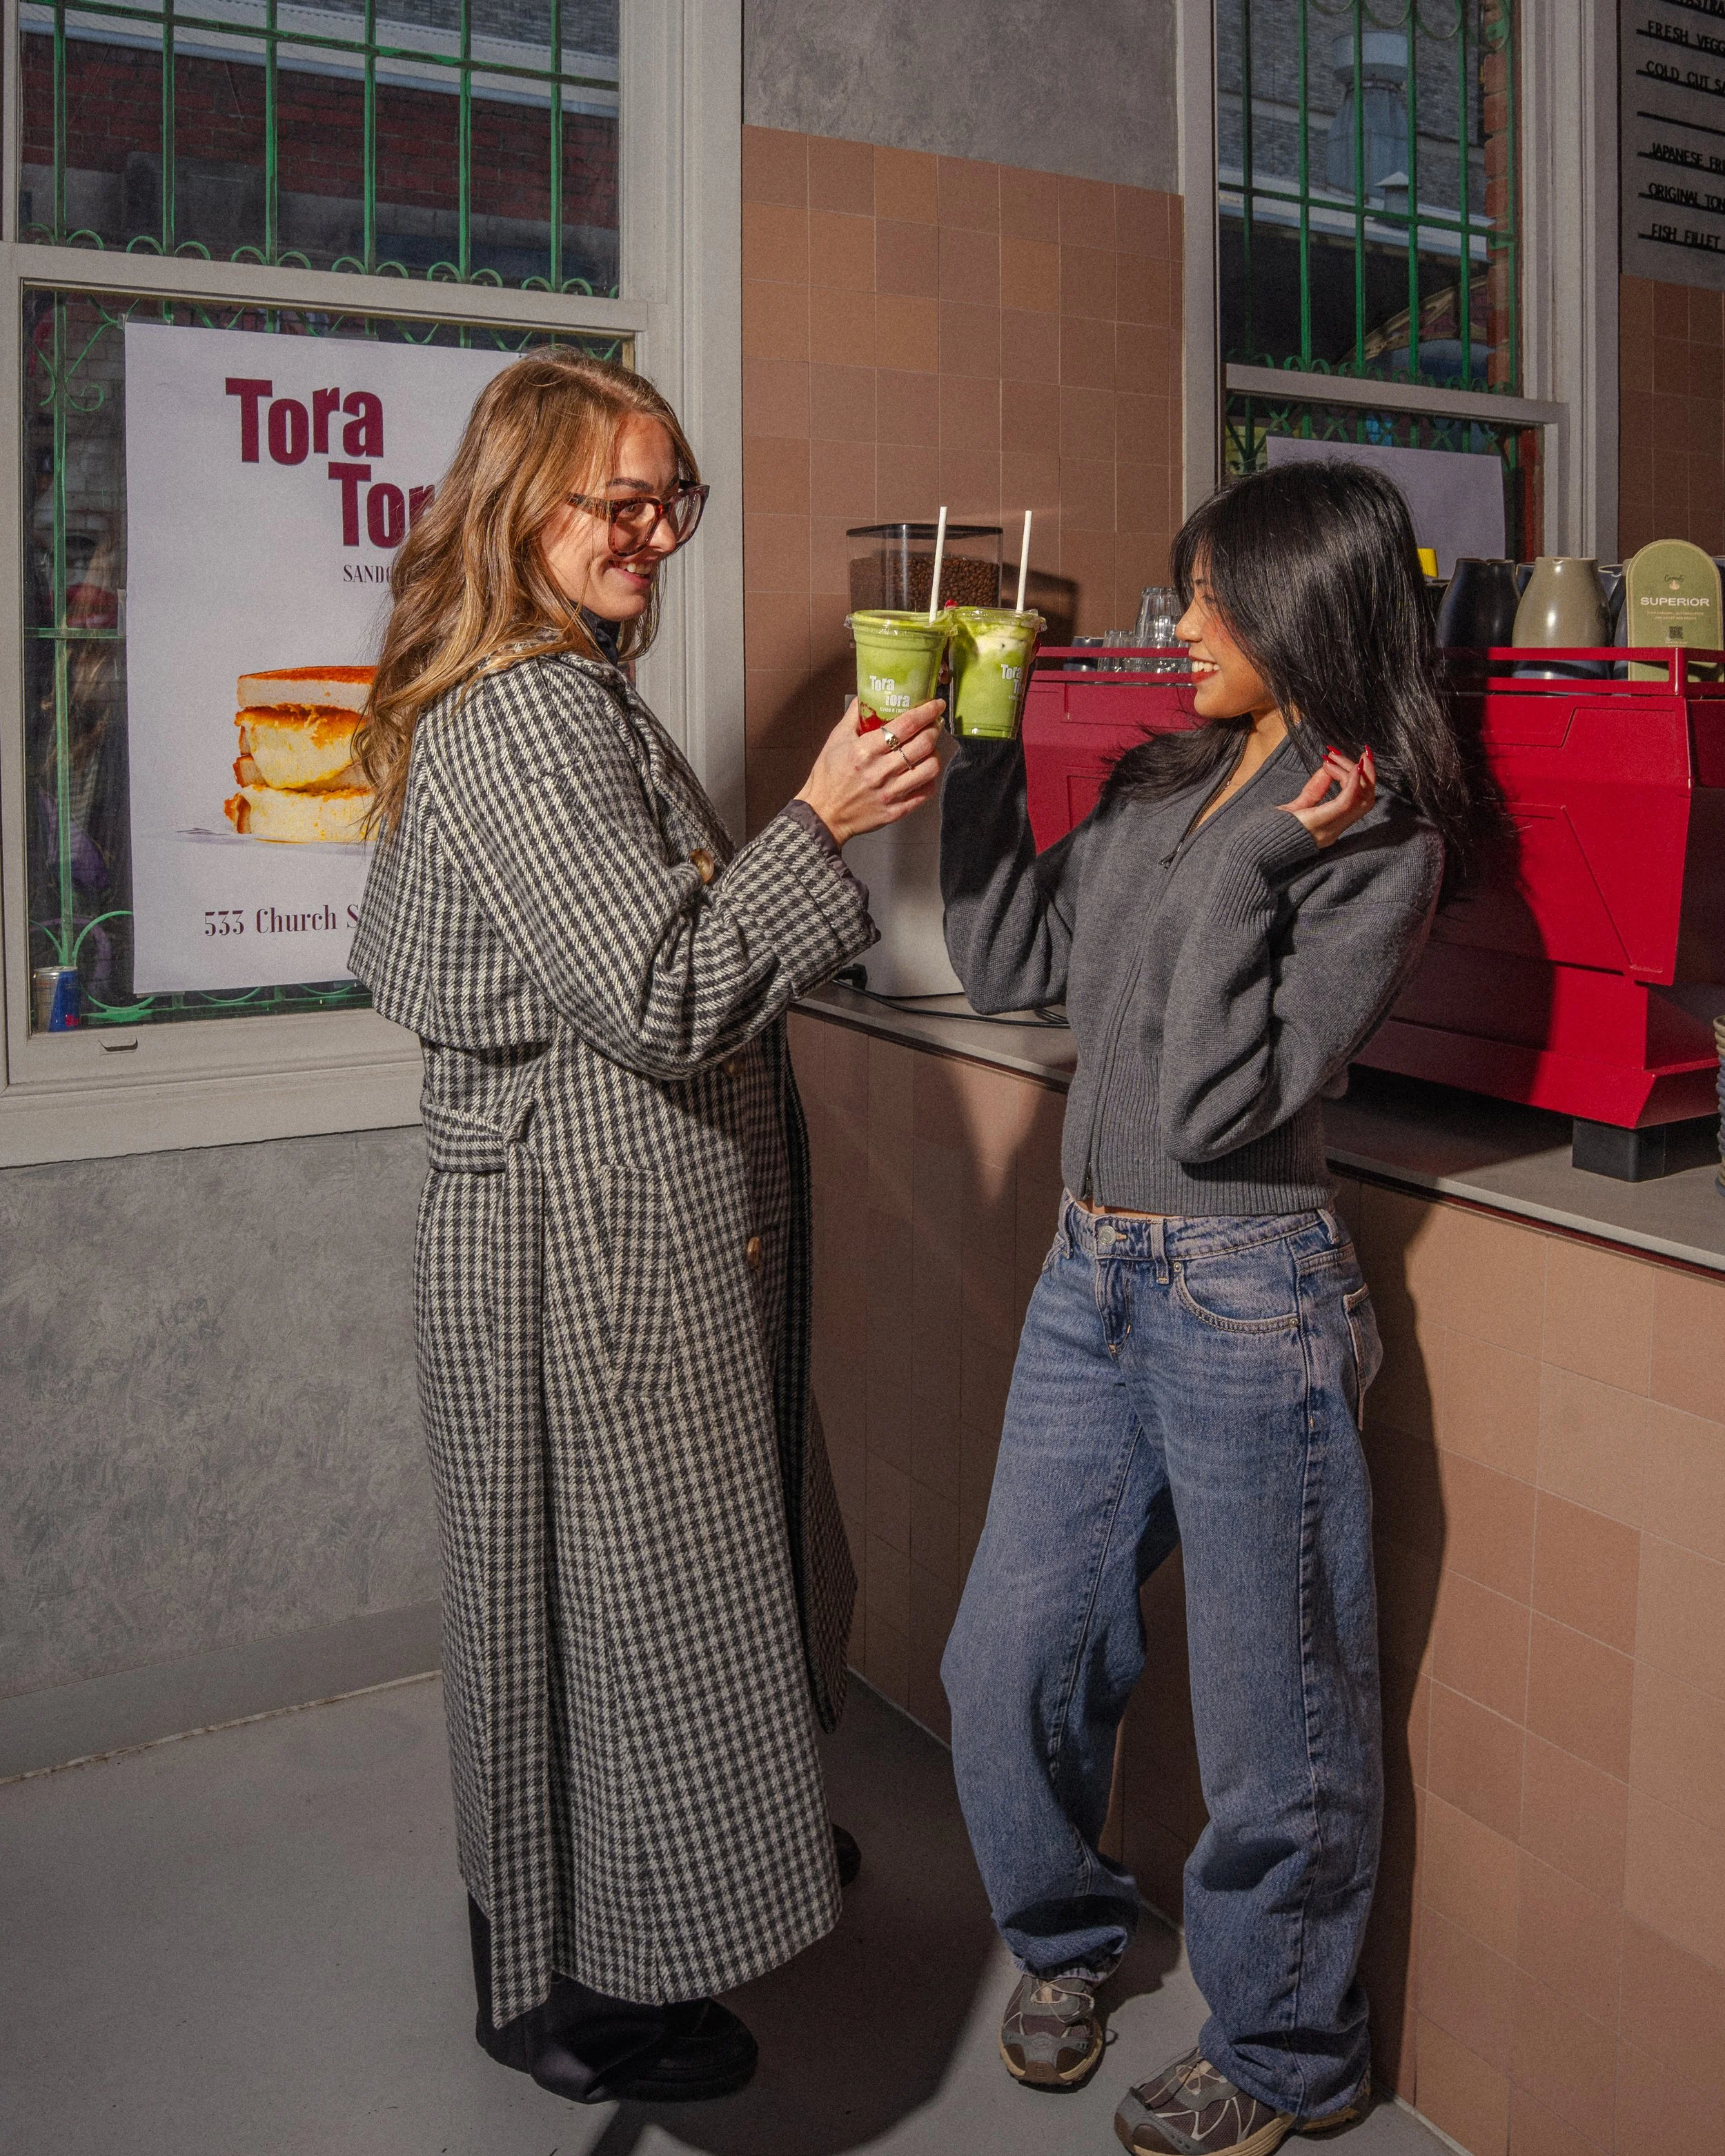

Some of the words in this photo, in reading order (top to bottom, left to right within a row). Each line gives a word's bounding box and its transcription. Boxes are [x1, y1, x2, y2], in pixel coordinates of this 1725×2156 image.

[1648, 20, 1688, 46] FRESH
[1646, 61, 1679, 83] COLD
[1687, 71, 1710, 90] CUT
[1651, 142, 1704, 168] JAPANESE
[1648, 182, 1698, 207] ORIGINAL
[1651, 223, 1677, 242] FISH
[1684, 229, 1722, 250] FILLET
[225, 377, 384, 466] Tora
[1640, 597, 1711, 607] SUPERIOR
[869, 675, 895, 691] Tora
[1001, 664, 1023, 680] Tora
[884, 691, 910, 707] Tora
[204, 910, 244, 936] 533
[256, 904, 338, 933] Church
